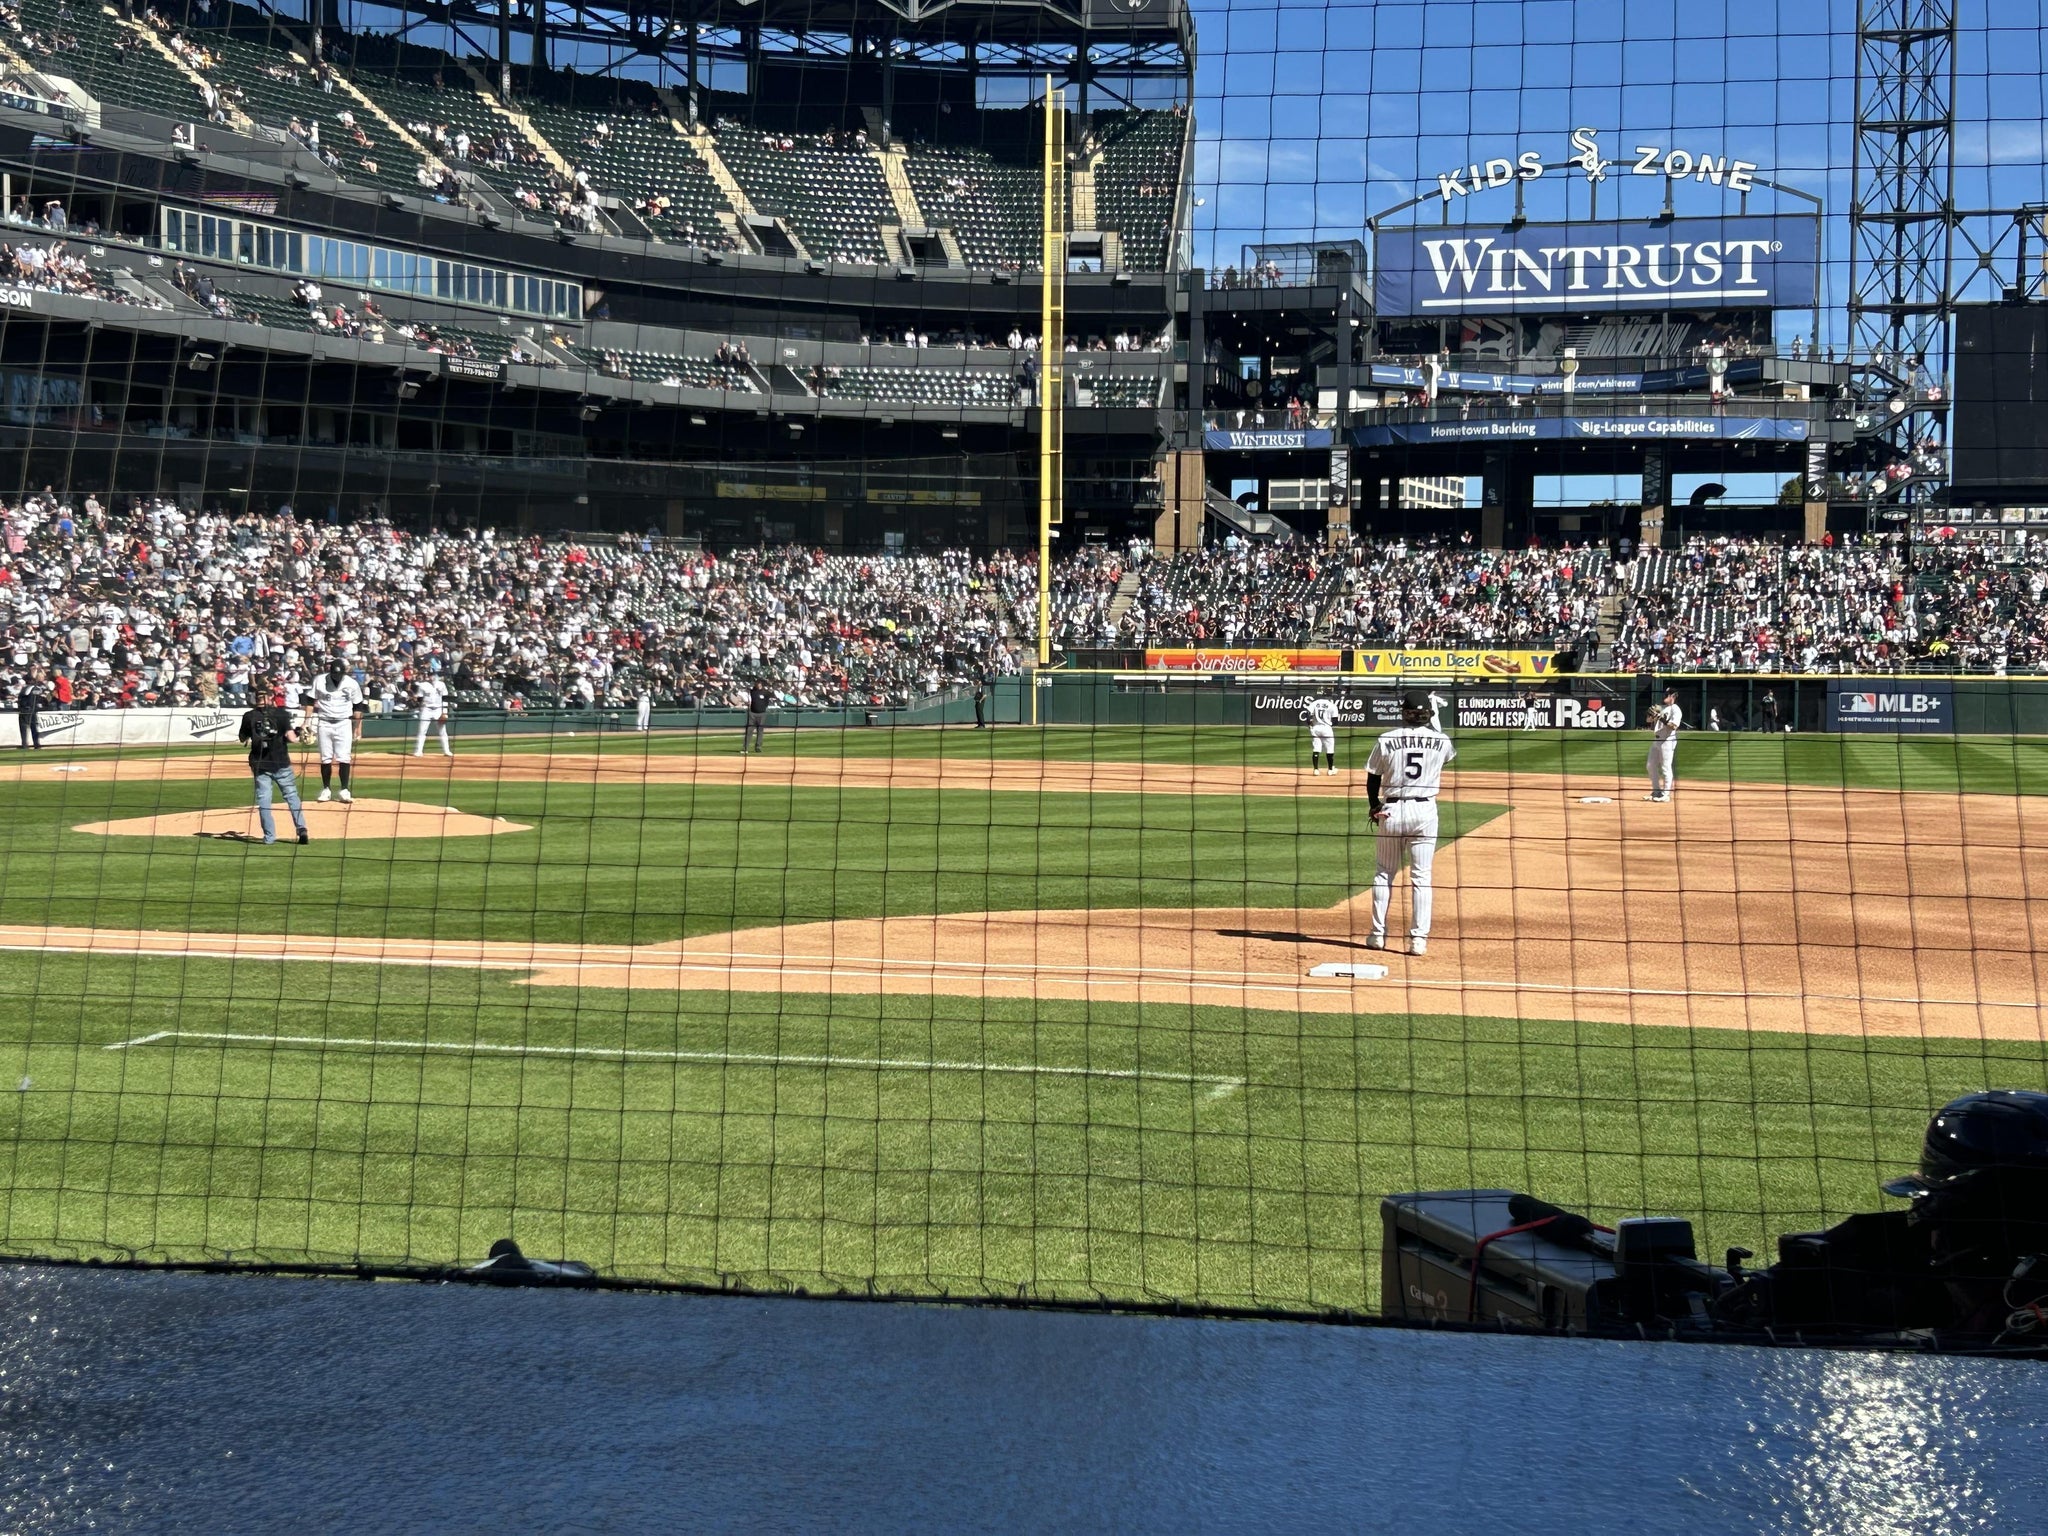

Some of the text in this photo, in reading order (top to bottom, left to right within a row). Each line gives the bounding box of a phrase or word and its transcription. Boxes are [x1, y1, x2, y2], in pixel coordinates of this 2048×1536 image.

[1437, 151, 1544, 201] KIDS
[1631, 146, 1759, 193] ZONE
[1431, 422, 1536, 437] Hometown Banking
[1582, 420, 1715, 436] Big-League Capabilities
[1229, 432, 1305, 446] WINTRUST
[1192, 652, 1256, 672] Surfside
[1388, 652, 1441, 667] Vienna
[1446, 652, 1480, 667] Beef
[1458, 699, 1469, 709] EL
[1469, 697, 1495, 709] ÚNICO
[1879, 694, 1941, 712] MLB+
[1458, 711, 1487, 727] 100%
[1490, 711, 1504, 727] EN
[1556, 699, 1626, 729] Rate
[1384, 736, 1444, 754] MURAKAMI
[1405, 752, 1424, 780] 5
